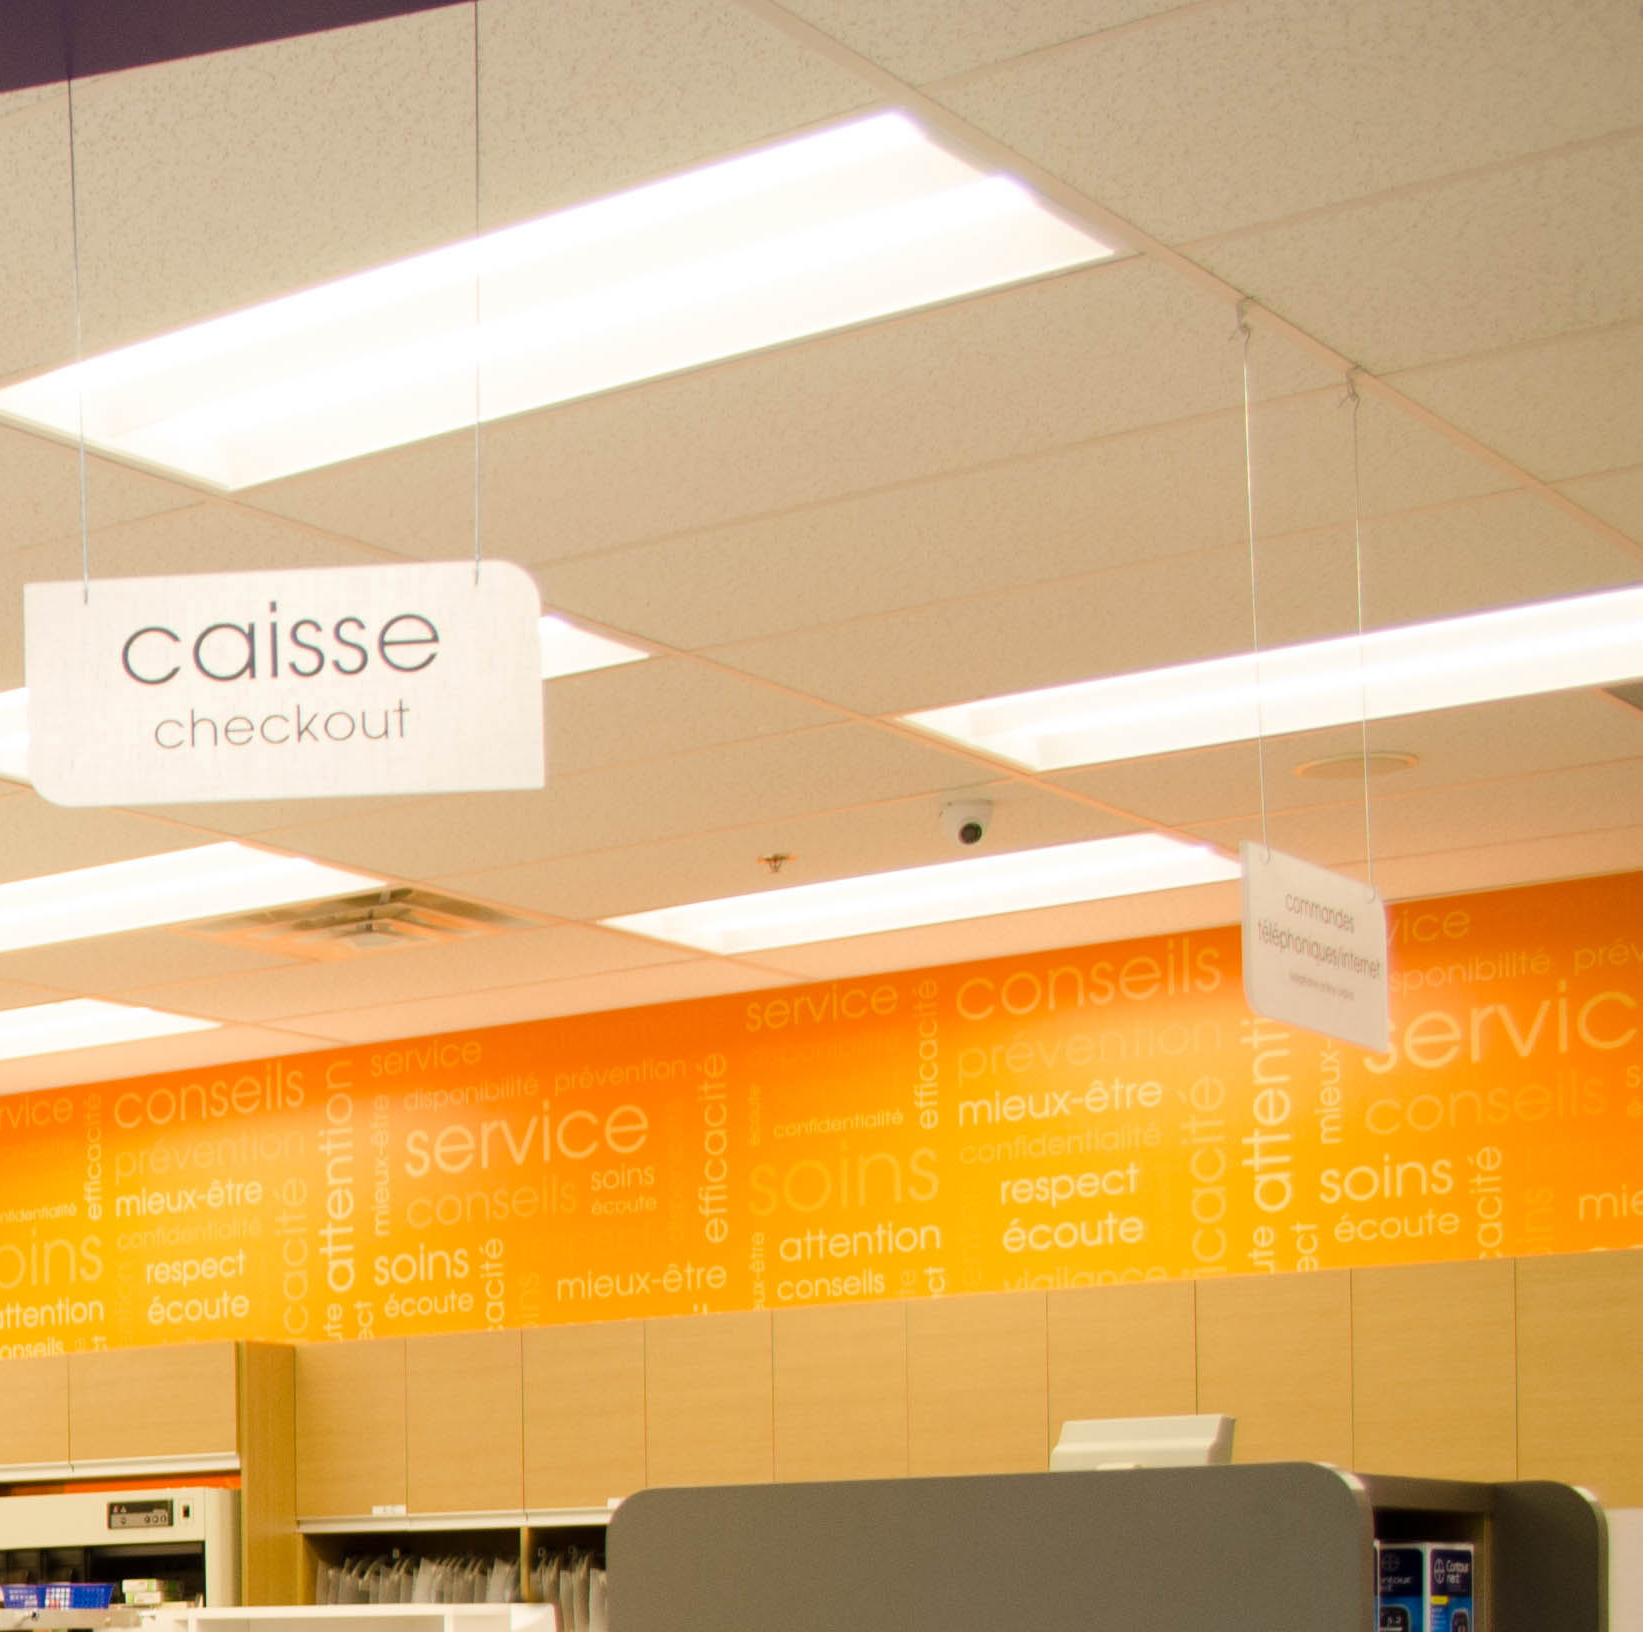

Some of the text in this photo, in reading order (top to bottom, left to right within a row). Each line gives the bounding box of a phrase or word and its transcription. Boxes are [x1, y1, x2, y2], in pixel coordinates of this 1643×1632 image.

[122, 601, 439, 685] caisse
[154, 698, 410, 749] checkout
[1284, 892, 1355, 933] commandes
[956, 937, 1222, 1021] conseils
[745, 983, 898, 1032] service
[1363, 979, 1638, 1074] servic
[370, 1039, 483, 1078] service
[554, 1056, 687, 1097] prévention
[912, 978, 940, 1130] efficacité
[957, 1020, 1223, 1089] prévention
[115, 1061, 306, 1129] conseils
[958, 1080, 1163, 1127] mieux-être
[1240, 1018, 1292, 1213] attenti
[1365, 1068, 1605, 1135] conseils
[404, 1099, 649, 1178] service
[773, 1108, 904, 1140] confidentialité
[959, 1120, 1162, 1165] confidentialité
[83, 1092, 103, 1222] efficacité
[115, 1129, 306, 1185] prévention
[370, 1093, 391, 1238] mieux-être
[697, 1053, 730, 1244] efficacité
[115, 1179, 264, 1218] mieux-être
[318, 1060, 355, 1293] attention
[590, 1162, 655, 1192] soins
[748, 1138, 940, 1218] soins
[1000, 1161, 1140, 1209] respect
[1319, 1153, 1454, 1204] soins
[405, 1174, 578, 1230] conseils
[591, 1194, 658, 1217] écoute
[1334, 1208, 1460, 1243] écoute
[778, 1221, 943, 1263] attention
[1001, 1211, 1145, 1254] écoute
[146, 1249, 246, 1288] respect
[373, 1243, 470, 1287] soins
[556, 1263, 728, 1302] mieux-être
[777, 1269, 886, 1302] conseils
[147, 1290, 251, 1326] écoute
[383, 1289, 475, 1319] écoute
